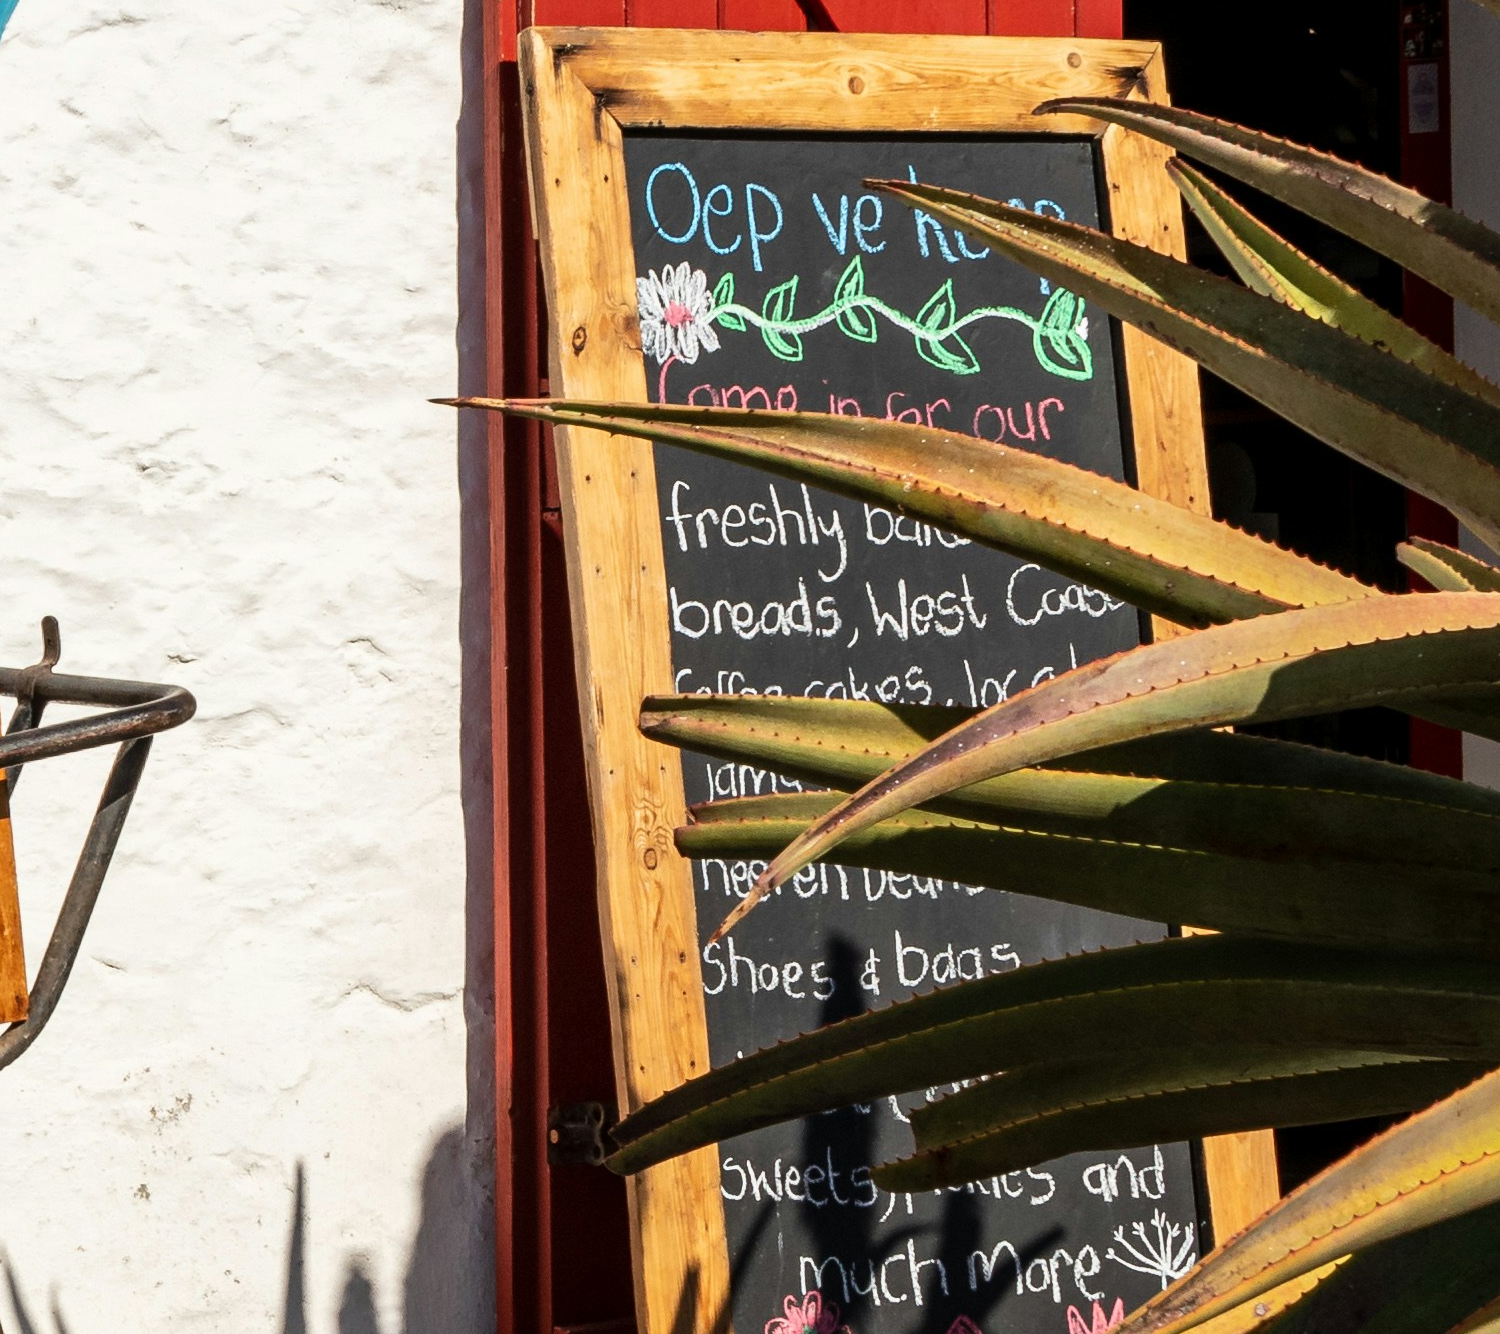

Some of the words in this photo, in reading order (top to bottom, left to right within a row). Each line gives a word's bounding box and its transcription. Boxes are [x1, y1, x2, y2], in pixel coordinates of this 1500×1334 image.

[645, 162, 783, 270] Oep
[811, 191, 886, 255] ve
[973, 397, 1065, 443] our
[665, 481, 849, 582] freshly
[670, 577, 858, 648] breads,
[866, 574, 988, 642] West
[1006, 563, 1126, 627] Coas
[702, 936, 835, 1001] Shoes
[1082, 1142, 1166, 1203] and
[799, 1238, 950, 1307] much
